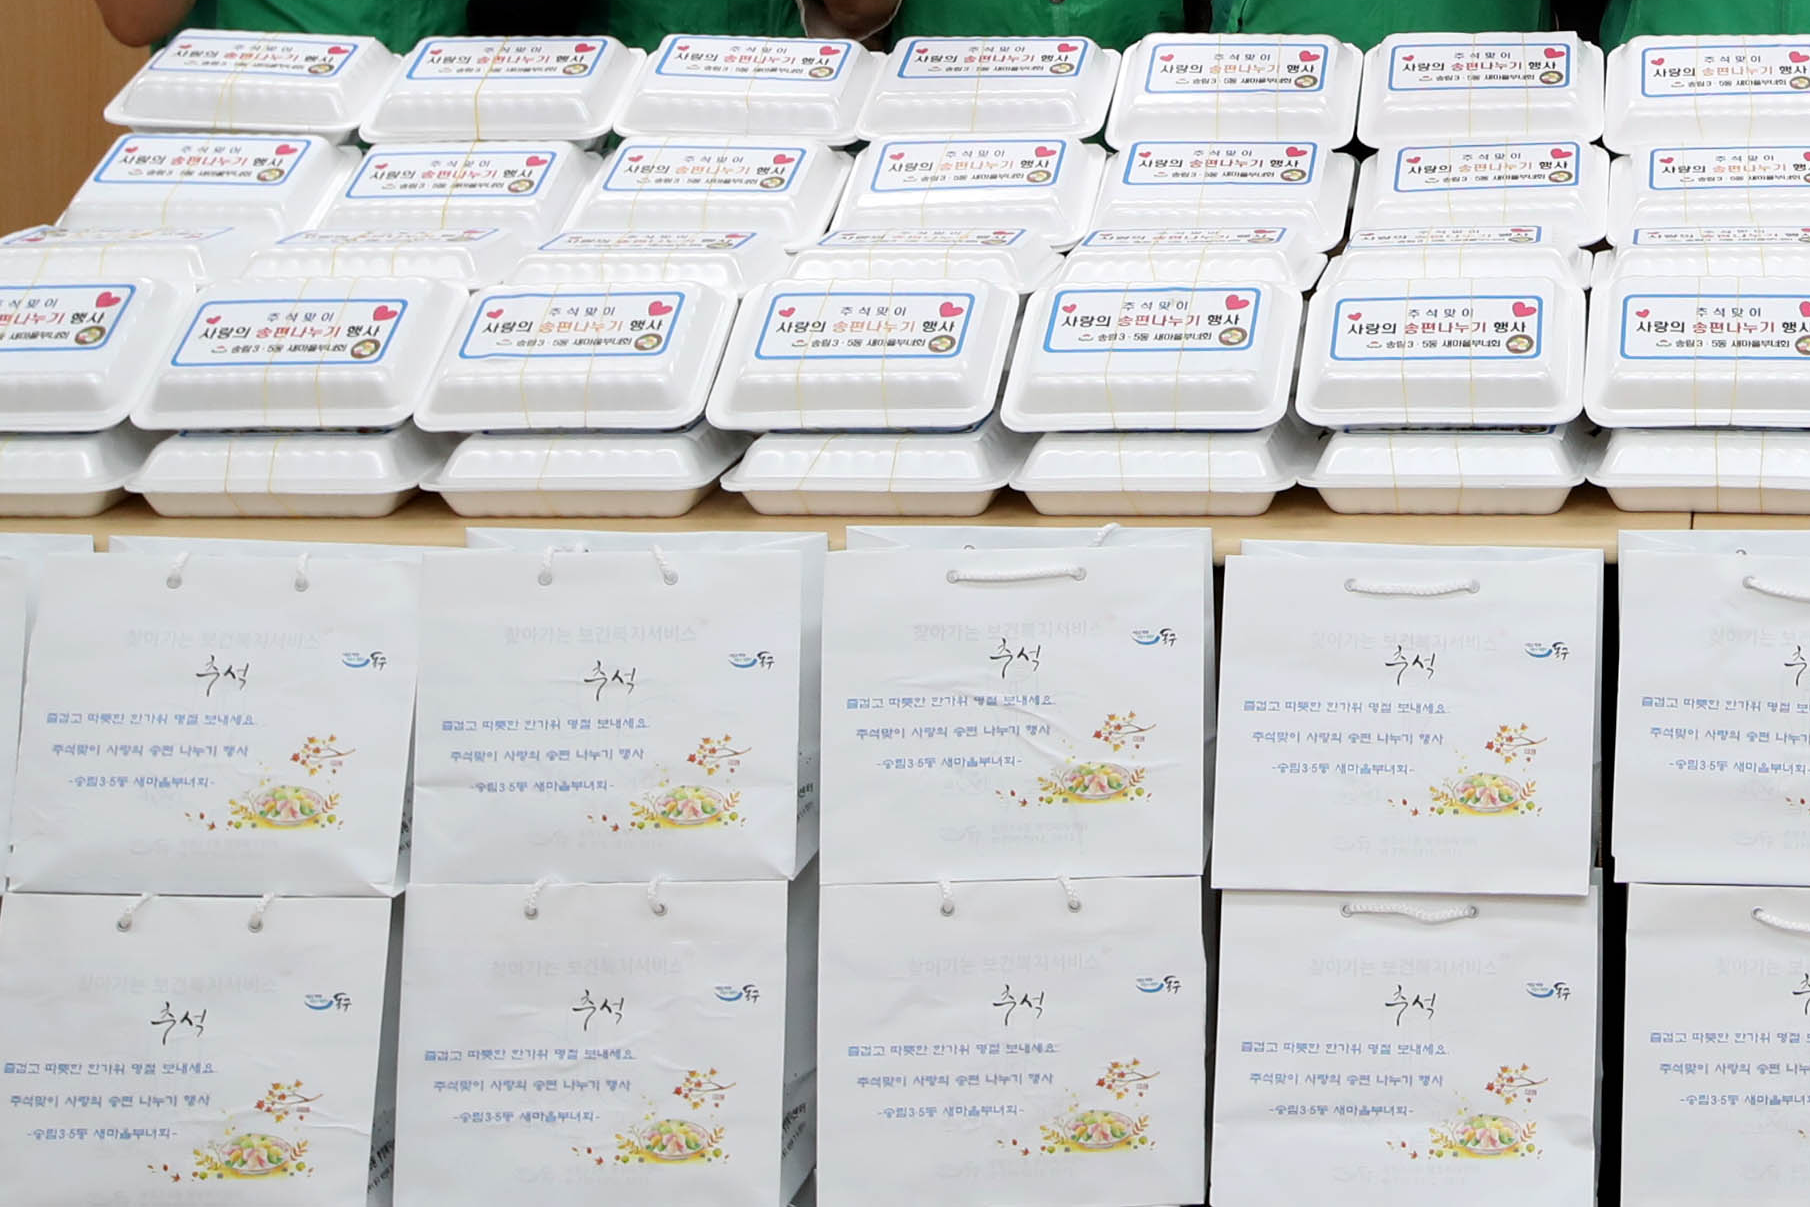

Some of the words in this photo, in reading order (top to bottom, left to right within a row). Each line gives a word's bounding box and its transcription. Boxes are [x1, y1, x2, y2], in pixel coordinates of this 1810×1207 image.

[70, 312, 104, 325] 행사
[198, 327, 253, 339] 사랑의
[252, 325, 343, 340] 송편나누기
[342, 325, 383, 338] 행사
[482, 321, 536, 333] 사랑의
[536, 319, 625, 333] 송편나누기
[625, 319, 664, 331] 행사
[776, 320, 828, 333] 사랑의
[830, 319, 917, 334] 송편나누기
[918, 320, 956, 333] 행사
[1062, 315, 1112, 327] 사랑의
[1115, 314, 1202, 328] 송편나누기
[1204, 313, 1242, 326] 행사
[1348, 323, 1398, 335] 사랑의
[1402, 321, 1488, 335] 송편나누기
[1491, 321, 1527, 334] 행사
[1637, 320, 1686, 333] 사랑의
[1691, 320, 1776, 335] 송편나누기
[193, 655, 250, 697] 추석
[989, 636, 1041, 679] 추석
[1384, 644, 1436, 686] 추석
[583, 659, 636, 702] 추석
[150, 1001, 207, 1045] 추석
[571, 989, 624, 1031] 추석
[992, 983, 1044, 1026] 추석
[1384, 985, 1436, 1027] 추석
